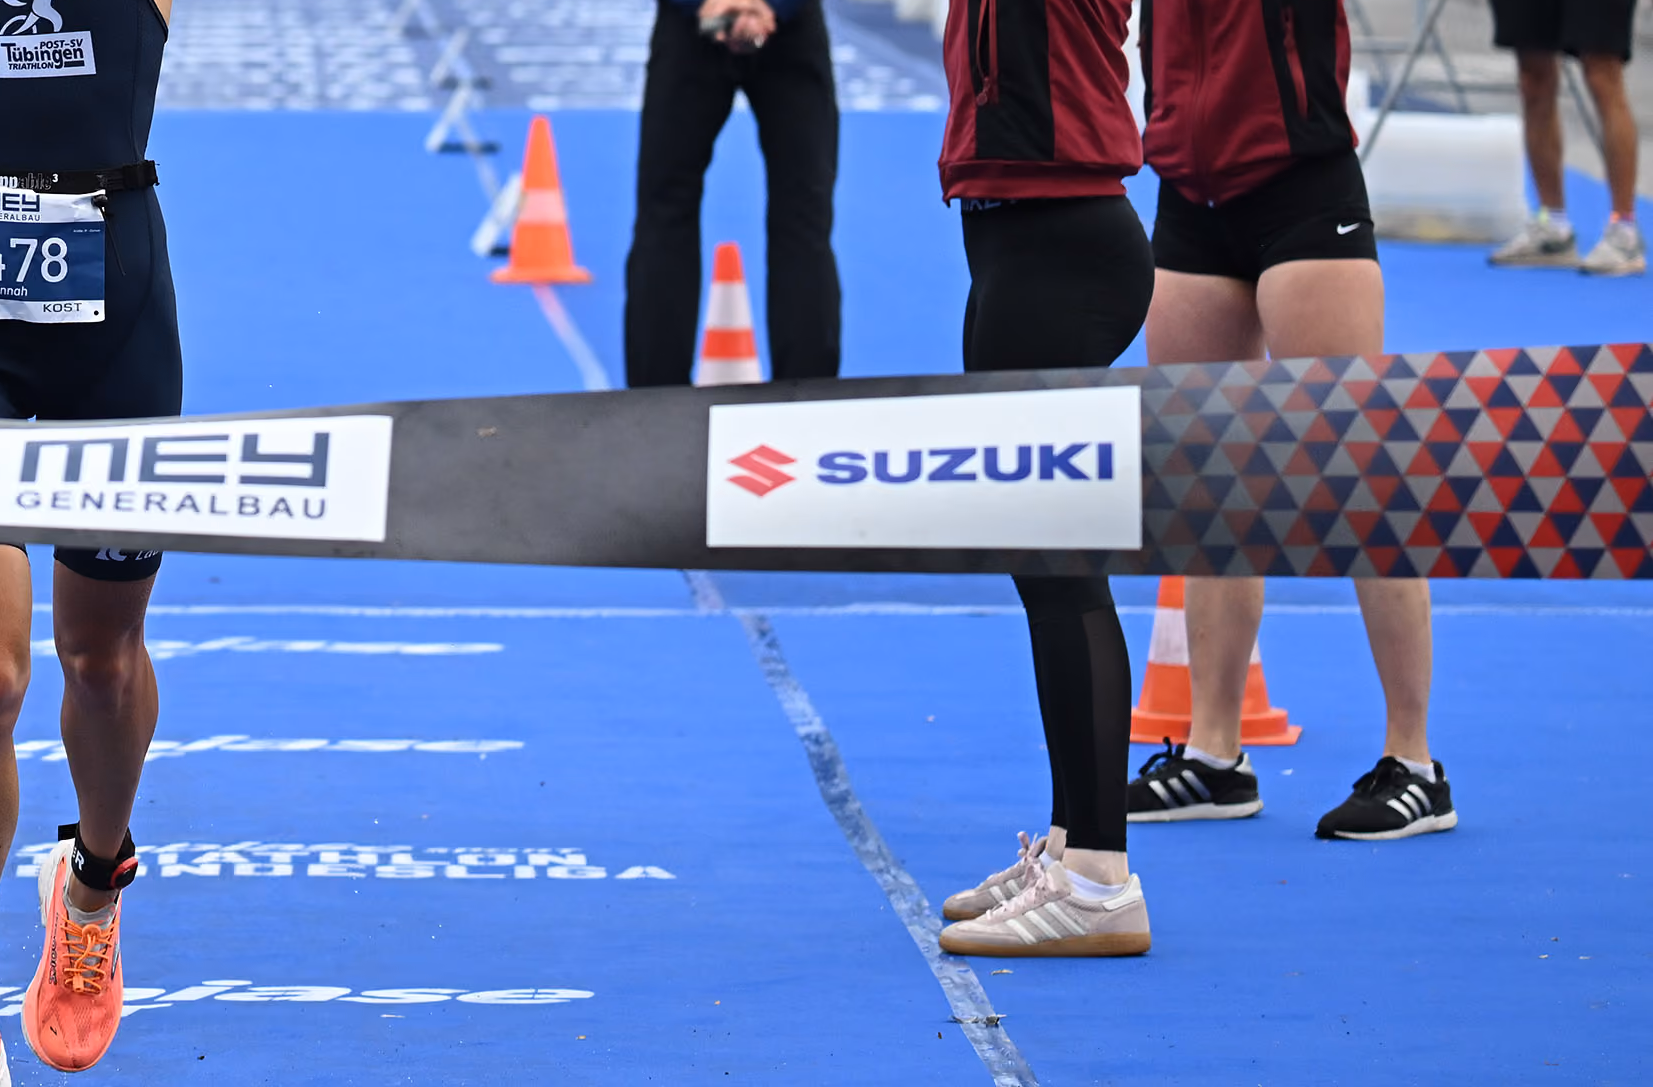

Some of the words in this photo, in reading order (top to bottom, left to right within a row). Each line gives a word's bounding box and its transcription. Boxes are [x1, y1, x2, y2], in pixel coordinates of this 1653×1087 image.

[0, 42, 84, 70] Tübingen
[8, 61, 54, 70] TRIATHLON
[42, 302, 83, 313] KOST
[19, 431, 331, 488] MEY
[815, 441, 1115, 486] SUZUKI
[15, 490, 328, 520] GENERALBAU
